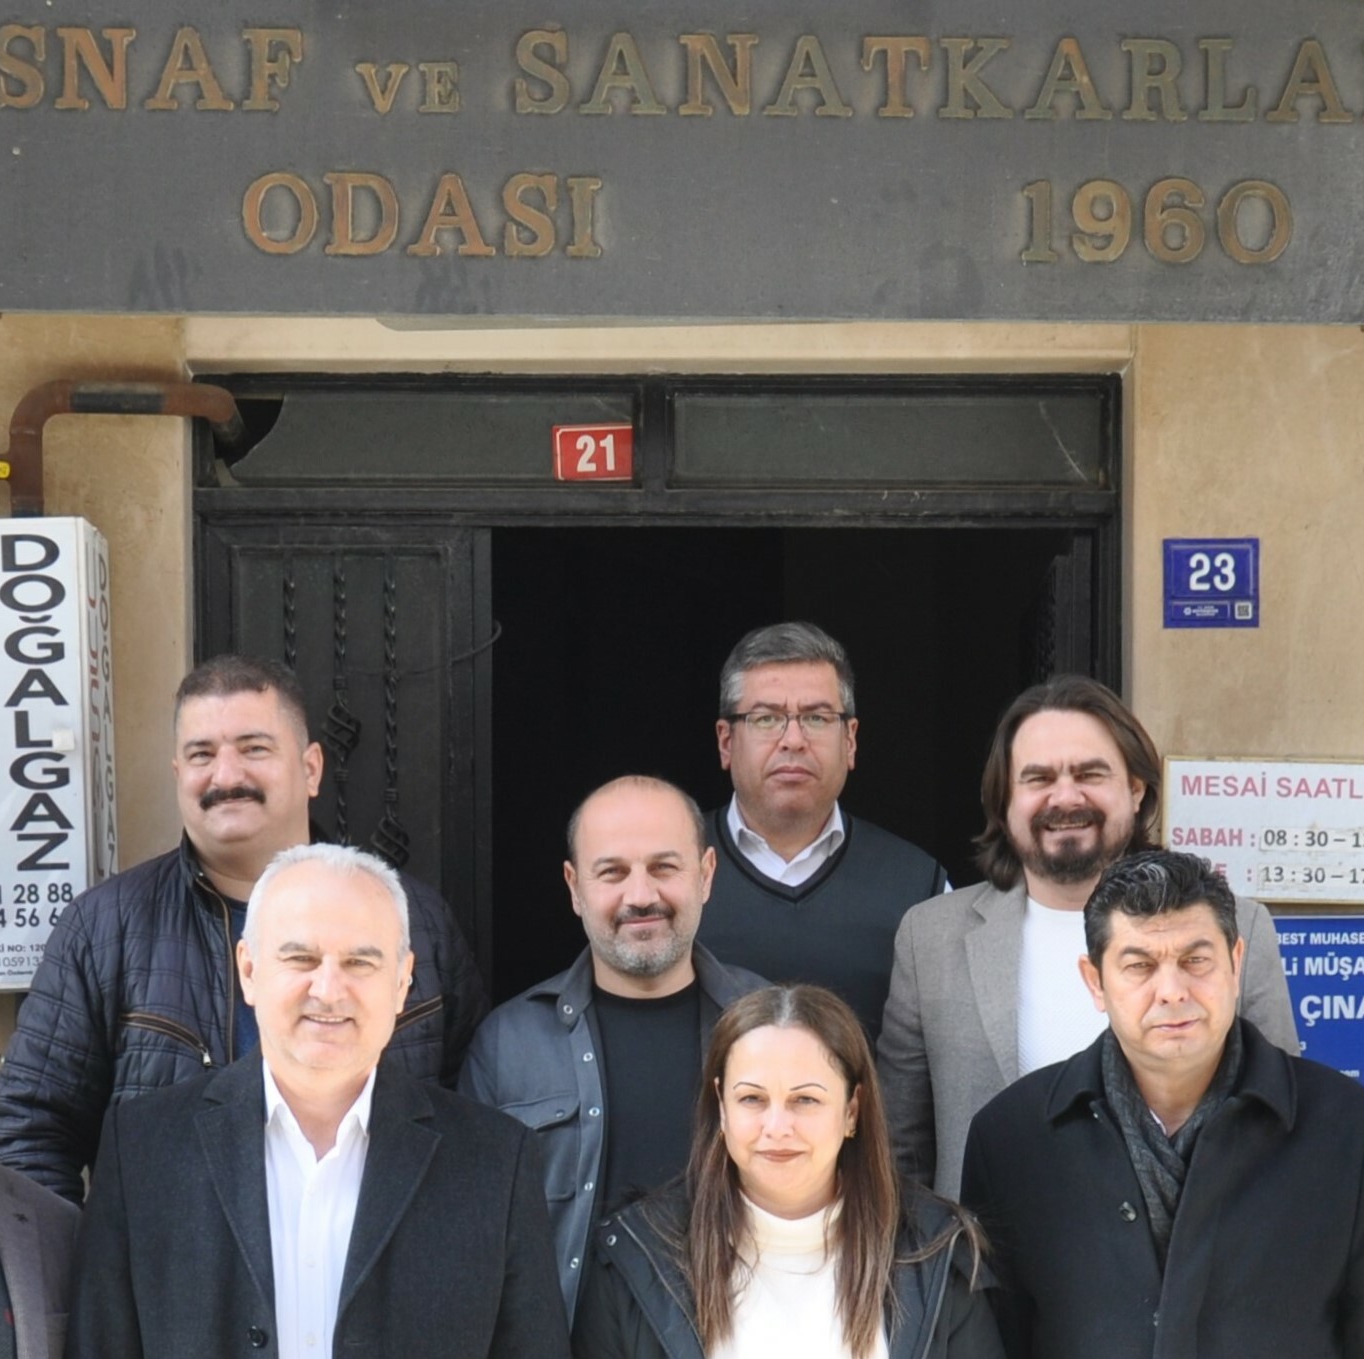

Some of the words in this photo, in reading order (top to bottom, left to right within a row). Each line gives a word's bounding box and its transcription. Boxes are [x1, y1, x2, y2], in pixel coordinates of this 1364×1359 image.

[241, 171, 605, 259] ODASI
[1022, 177, 1295, 266] 1960
[576, 434, 616, 473] 21
[1189, 552, 1236, 591] 23
[1181, 772, 1267, 798] MESAİ
[1171, 827, 1243, 847] SABAH
[13, 883, 40, 904] 28
[47, 882, 74, 903] 88
[14, 908, 40, 928] 56
[30, 943, 47, 952] 120
[1276, 932, 1307, 945] BEST
